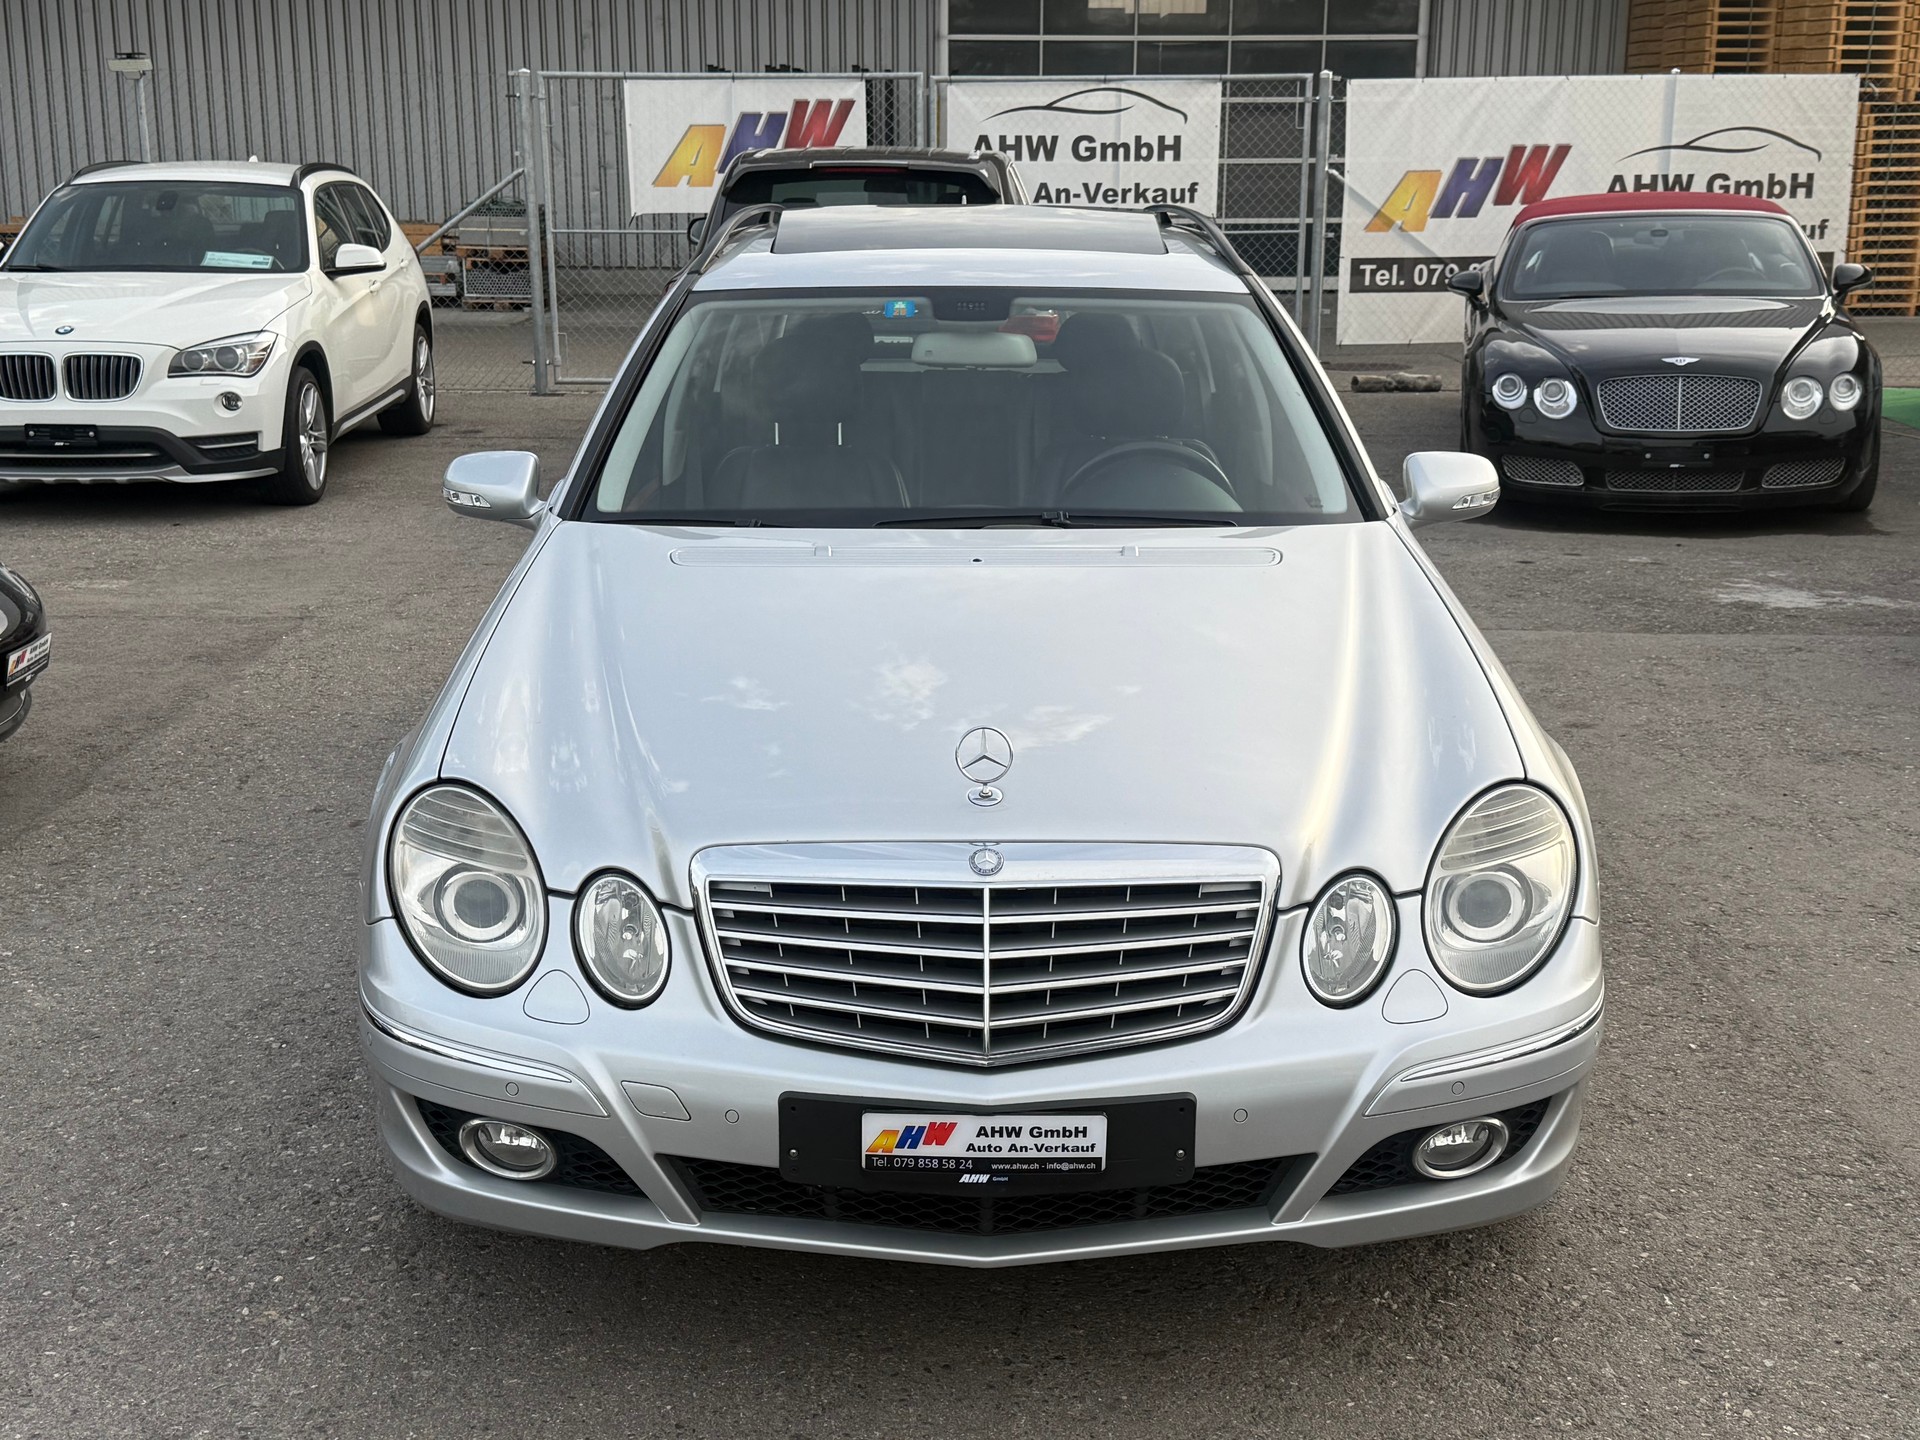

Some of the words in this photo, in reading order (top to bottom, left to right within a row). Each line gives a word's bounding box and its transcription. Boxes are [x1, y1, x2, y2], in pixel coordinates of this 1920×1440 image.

[652, 98, 856, 187] AHW
[974, 134, 1059, 162] AHW
[1071, 134, 1182, 162] GmbH
[1033, 181, 1199, 204] An-Verkauf
[1364, 143, 1573, 232] AHW
[1606, 173, 1695, 194] AHW
[1706, 172, 1815, 199] GmbH
[1359, 264, 1405, 286] Tel.
[866, 1121, 958, 1153] AHW
[976, 1126, 1023, 1139] AHW
[1029, 1126, 1088, 1139] GmbH
[966, 1143, 1003, 1153] Auto
[1007, 1142, 1097, 1153] An-Verkauf
[871, 1157, 890, 1167] Tel.
[893, 1158, 915, 1168] 079
[917, 1158, 939, 1169] 858
[942, 1159, 956, 1170] 58
[959, 1159, 973, 1170] 24
[991, 1162, 1040, 1170] www.ahw.ch
[1046, 1162, 1096, 1171] info@ahw.ch
[958, 1174, 991, 1184] AHW
